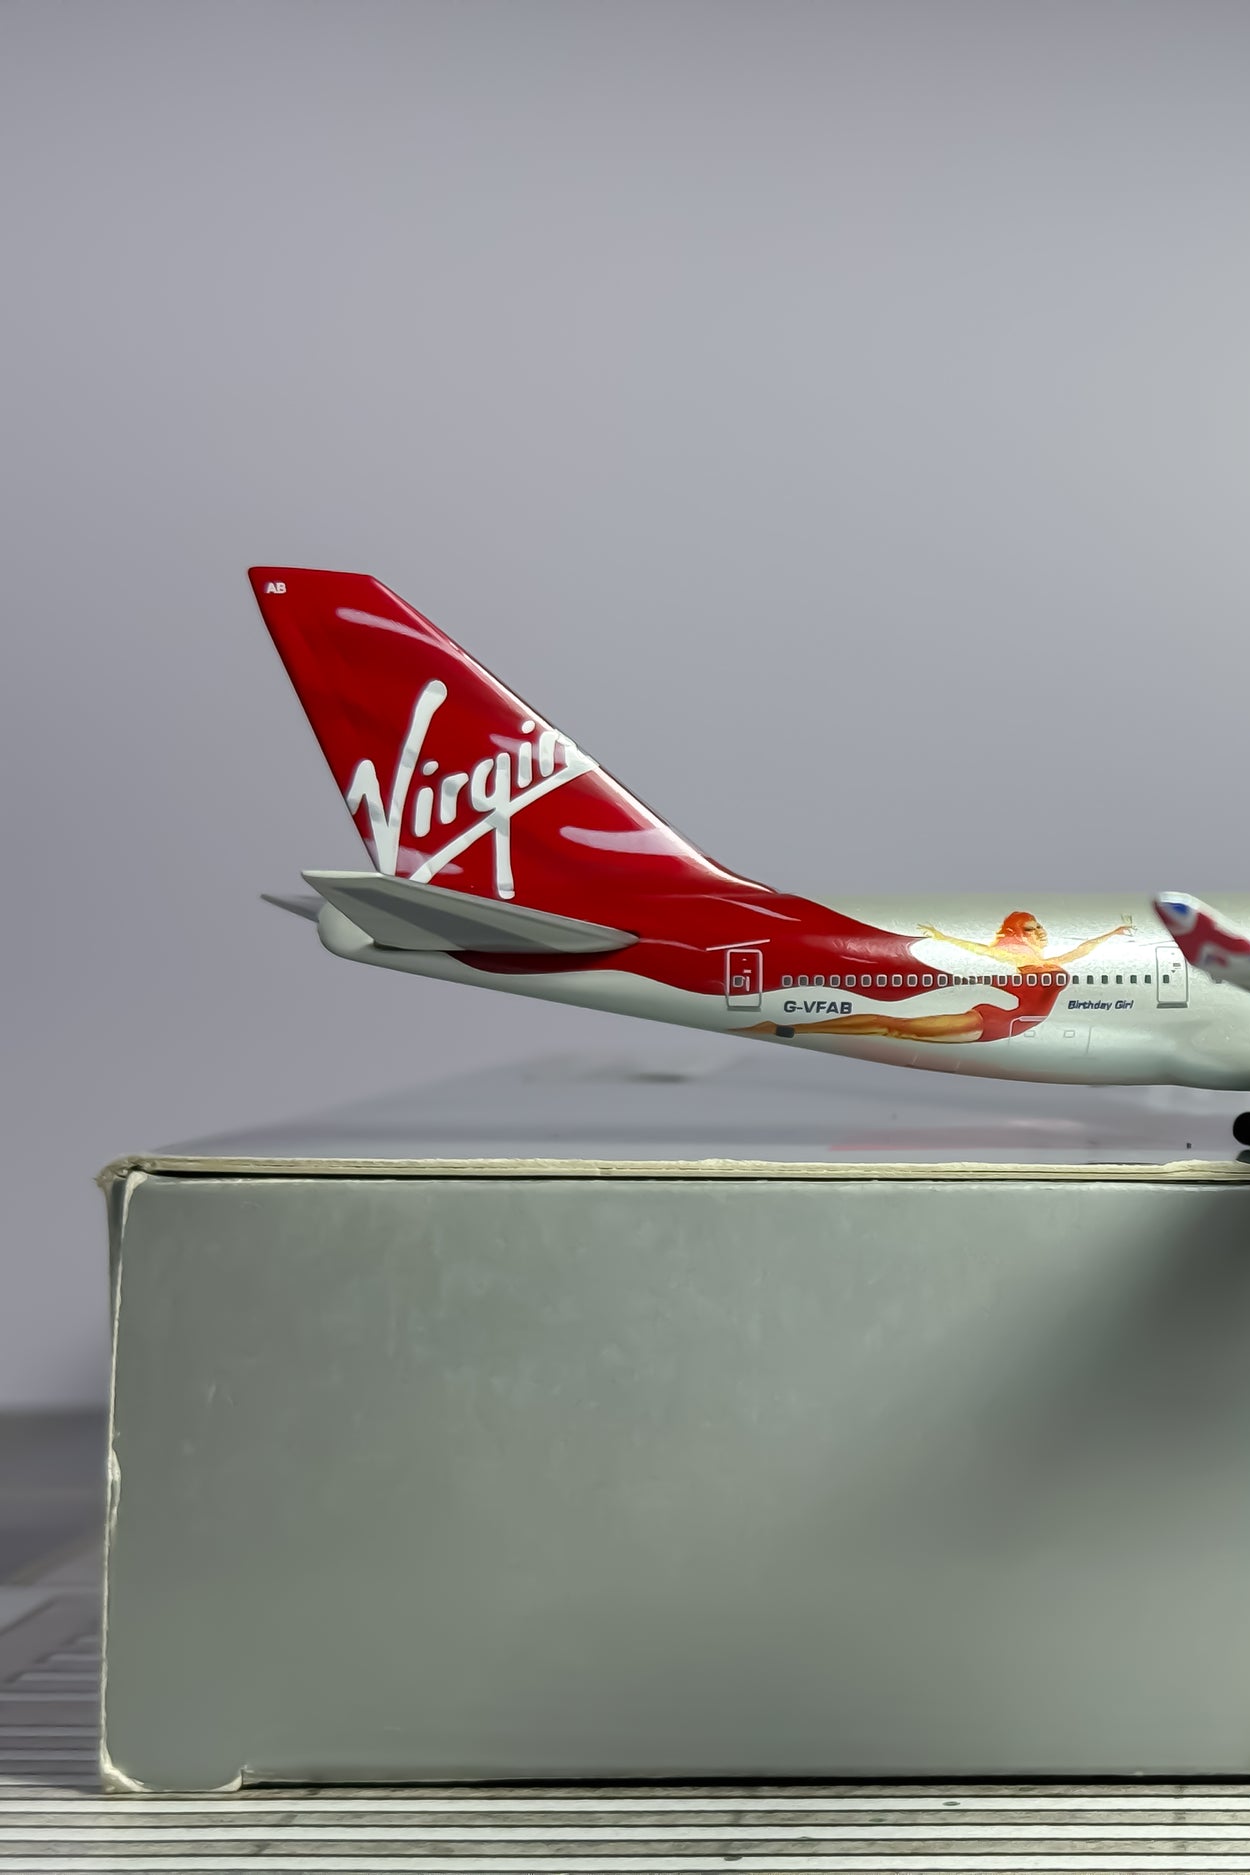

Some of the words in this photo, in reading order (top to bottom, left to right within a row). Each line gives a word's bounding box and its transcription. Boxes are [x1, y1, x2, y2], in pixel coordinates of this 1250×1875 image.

[266, 582, 287, 594] AB
[347, 680, 600, 899] Virgin
[783, 1000, 853, 1014] G-VFAB
[1068, 1000, 1112, 1010] Birthday
[1114, 1000, 1134, 1010] Girl
